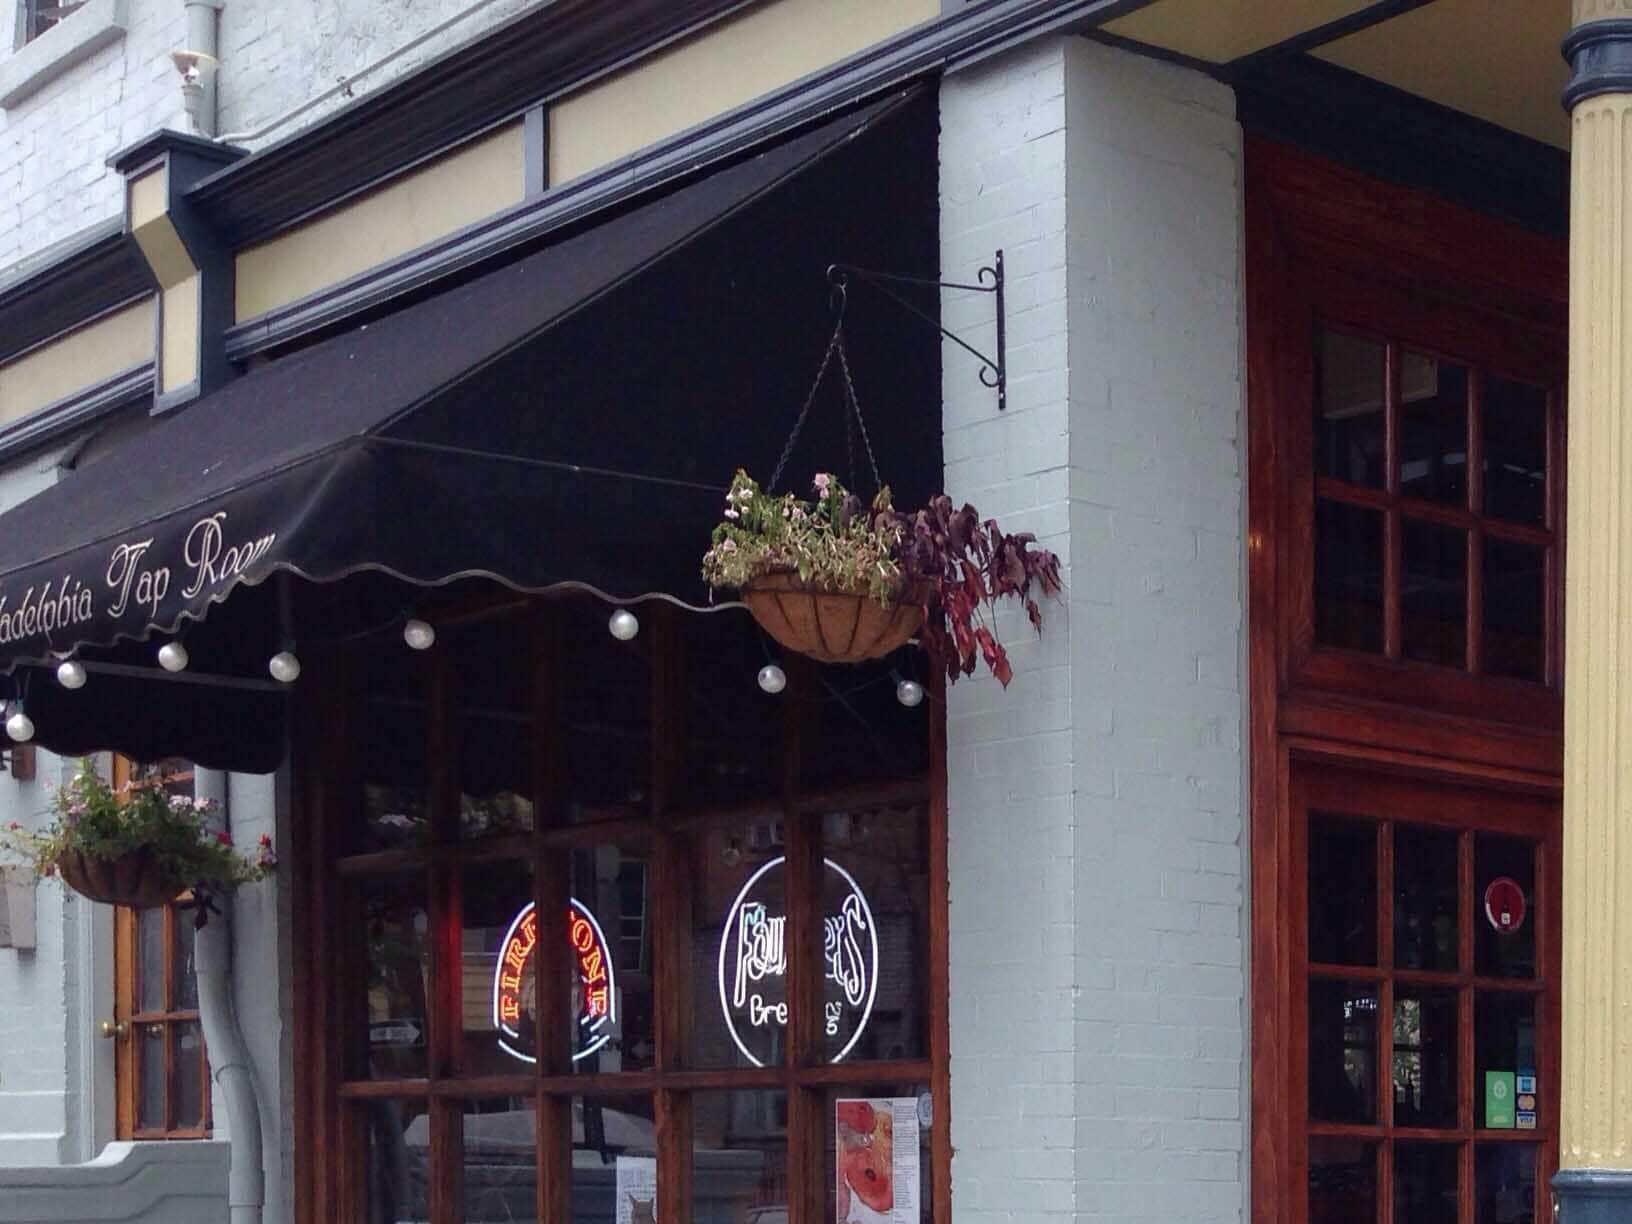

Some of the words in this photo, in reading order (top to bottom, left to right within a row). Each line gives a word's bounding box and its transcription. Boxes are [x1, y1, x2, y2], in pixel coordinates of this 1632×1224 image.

[107, 537, 171, 618] Tap
[181, 511, 277, 599] Room
[750, 994, 842, 1035] Breg
